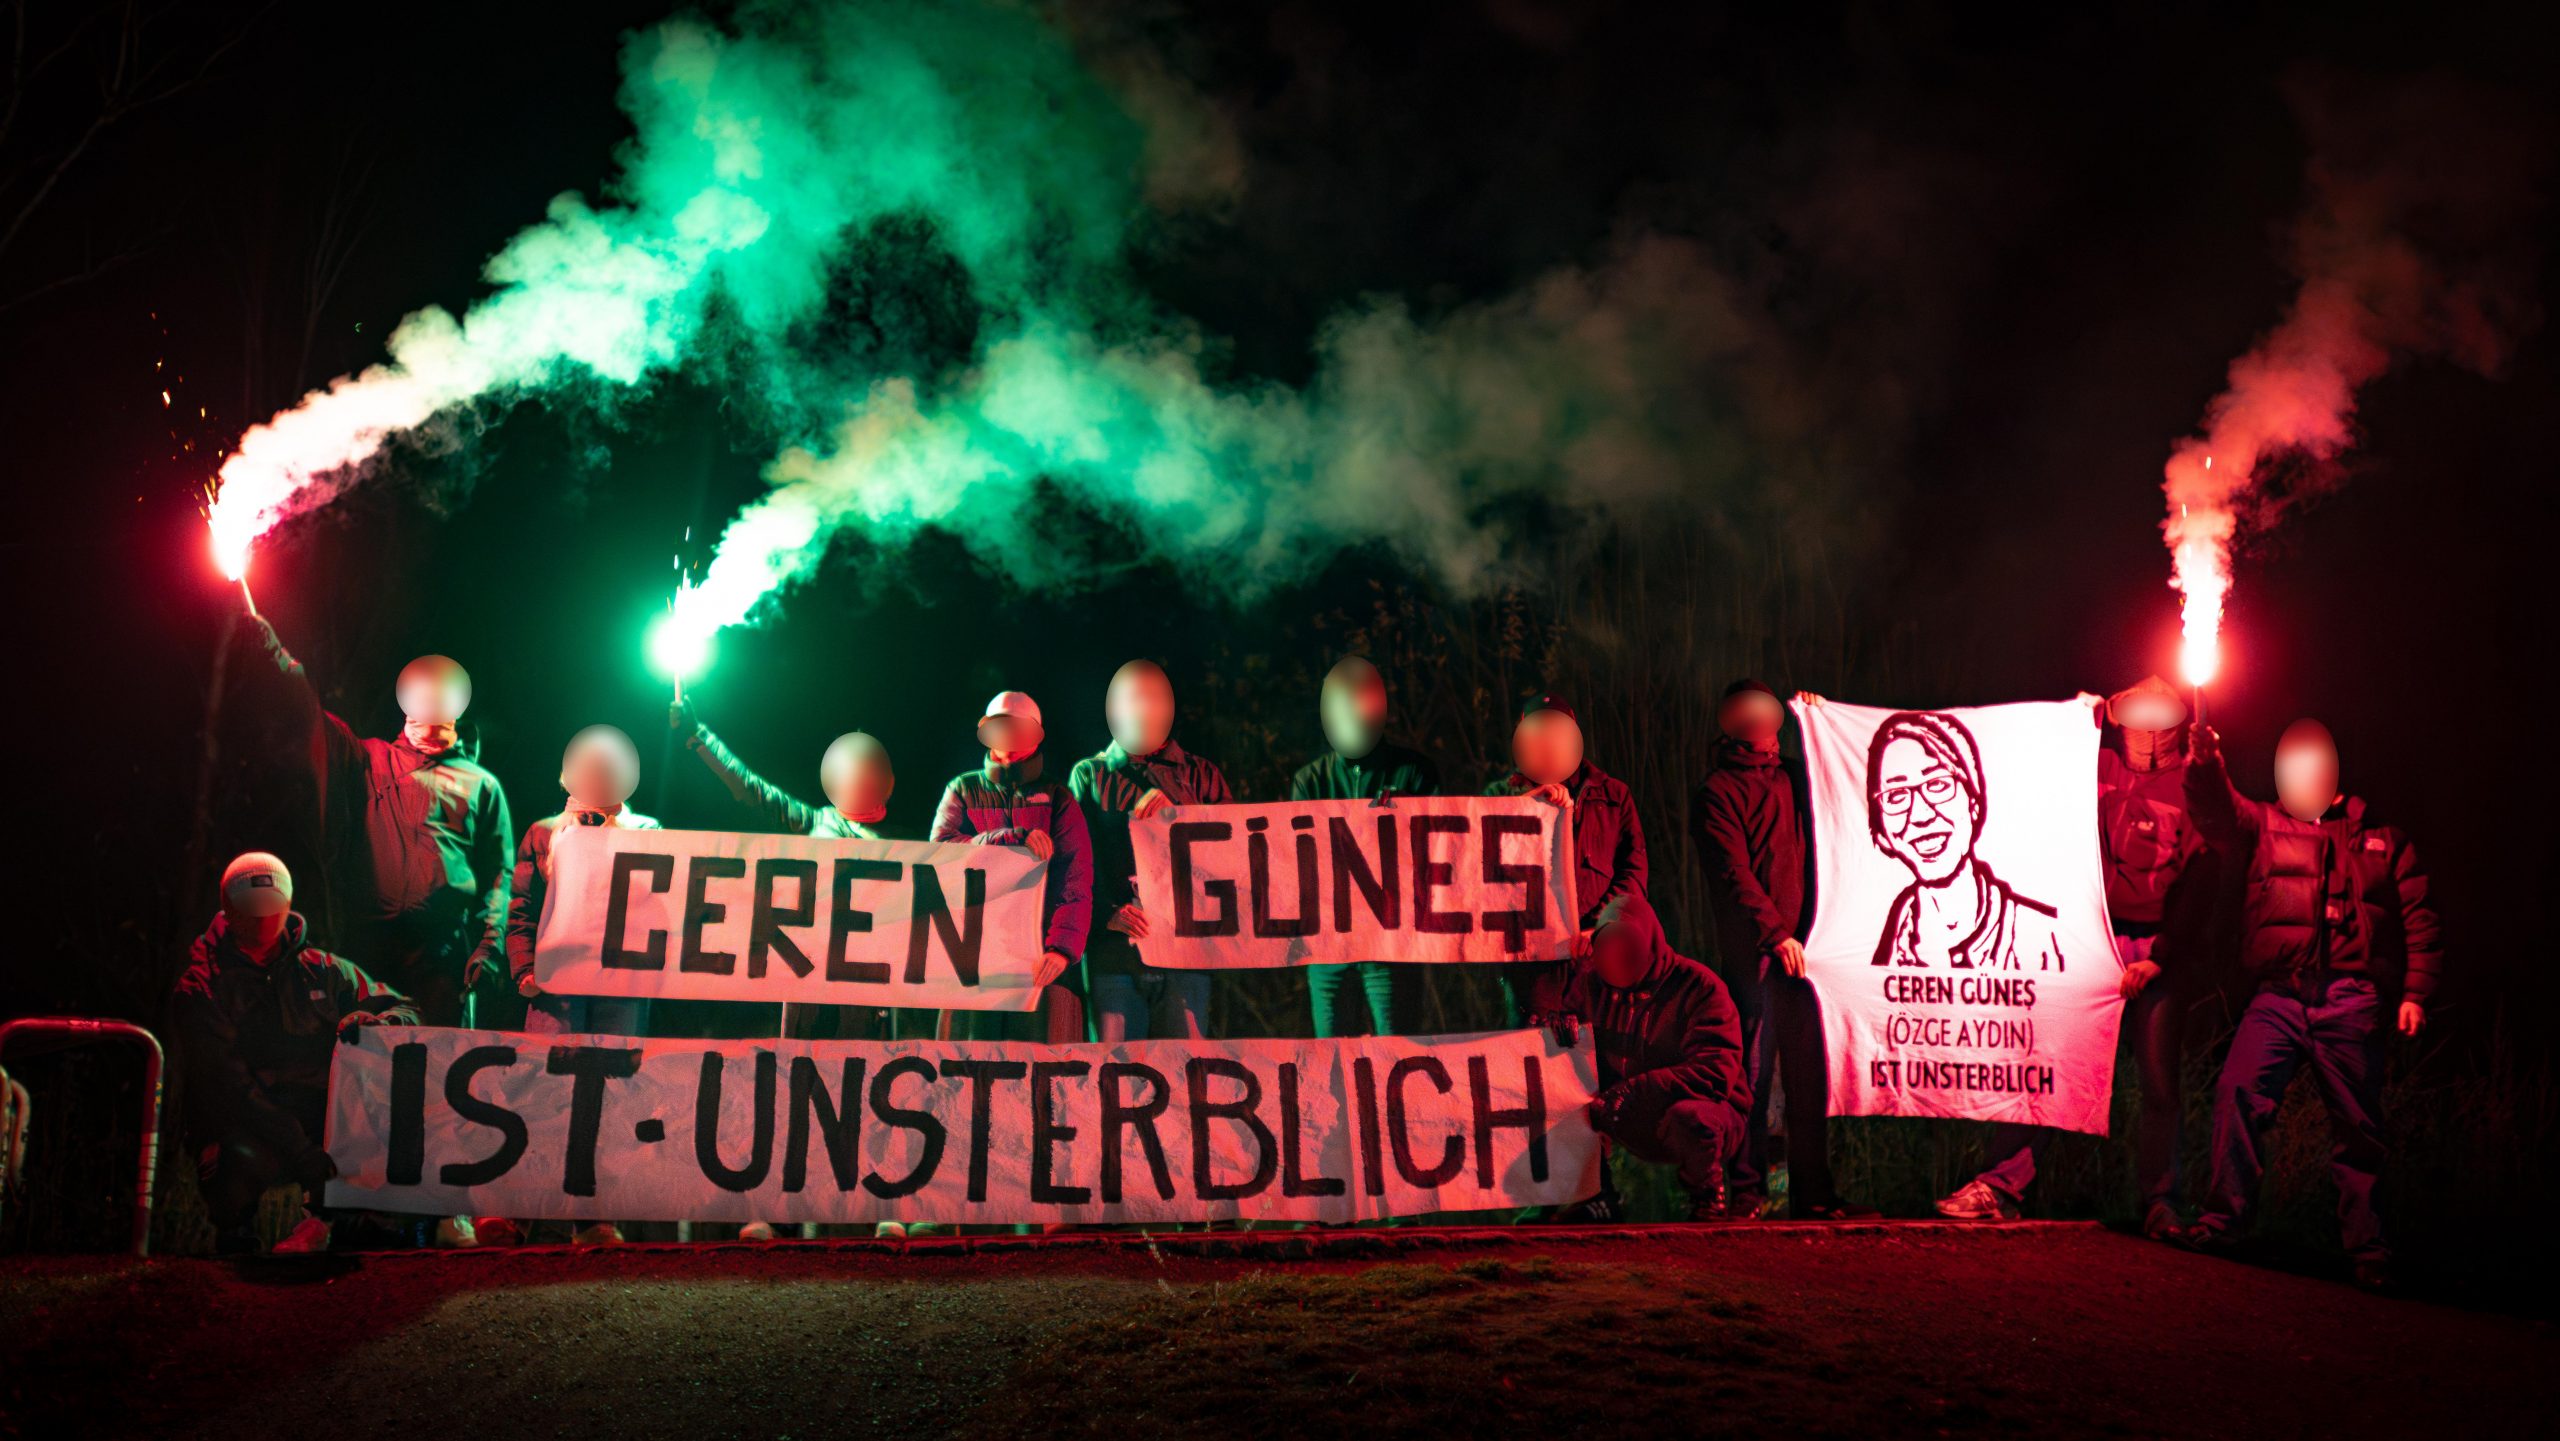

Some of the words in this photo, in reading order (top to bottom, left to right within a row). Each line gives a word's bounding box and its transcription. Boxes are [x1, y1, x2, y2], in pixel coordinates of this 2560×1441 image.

[1169, 814, 1546, 953] GÜNEŞ
[602, 852, 986, 986] CEREN
[1884, 975, 1954, 1004] CEREN
[1960, 973, 2036, 1010] GÜNEŞ
[1887, 1012, 1951, 1049] (ÖZGE
[1956, 1018, 2034, 1056] AYDIN)
[1871, 1061, 1901, 1088] IST
[1906, 1061, 2054, 1095] UNSTERBLICH
